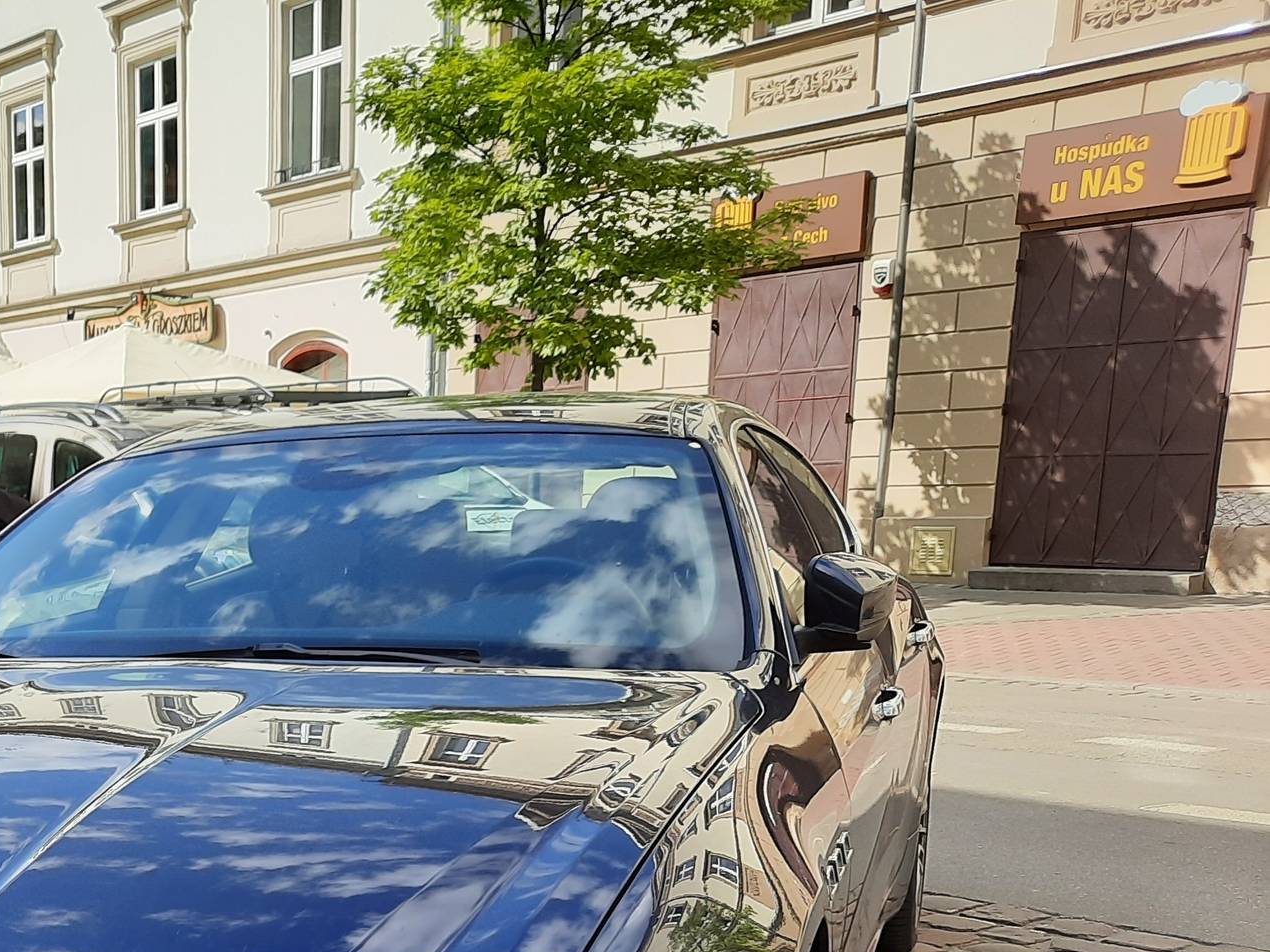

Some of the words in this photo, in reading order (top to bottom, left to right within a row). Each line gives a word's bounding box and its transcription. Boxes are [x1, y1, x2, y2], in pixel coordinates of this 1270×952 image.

[1053, 132, 1150, 165] Hospůdka
[1050, 181, 1068, 204] u
[1079, 156, 1146, 200] NÁS
